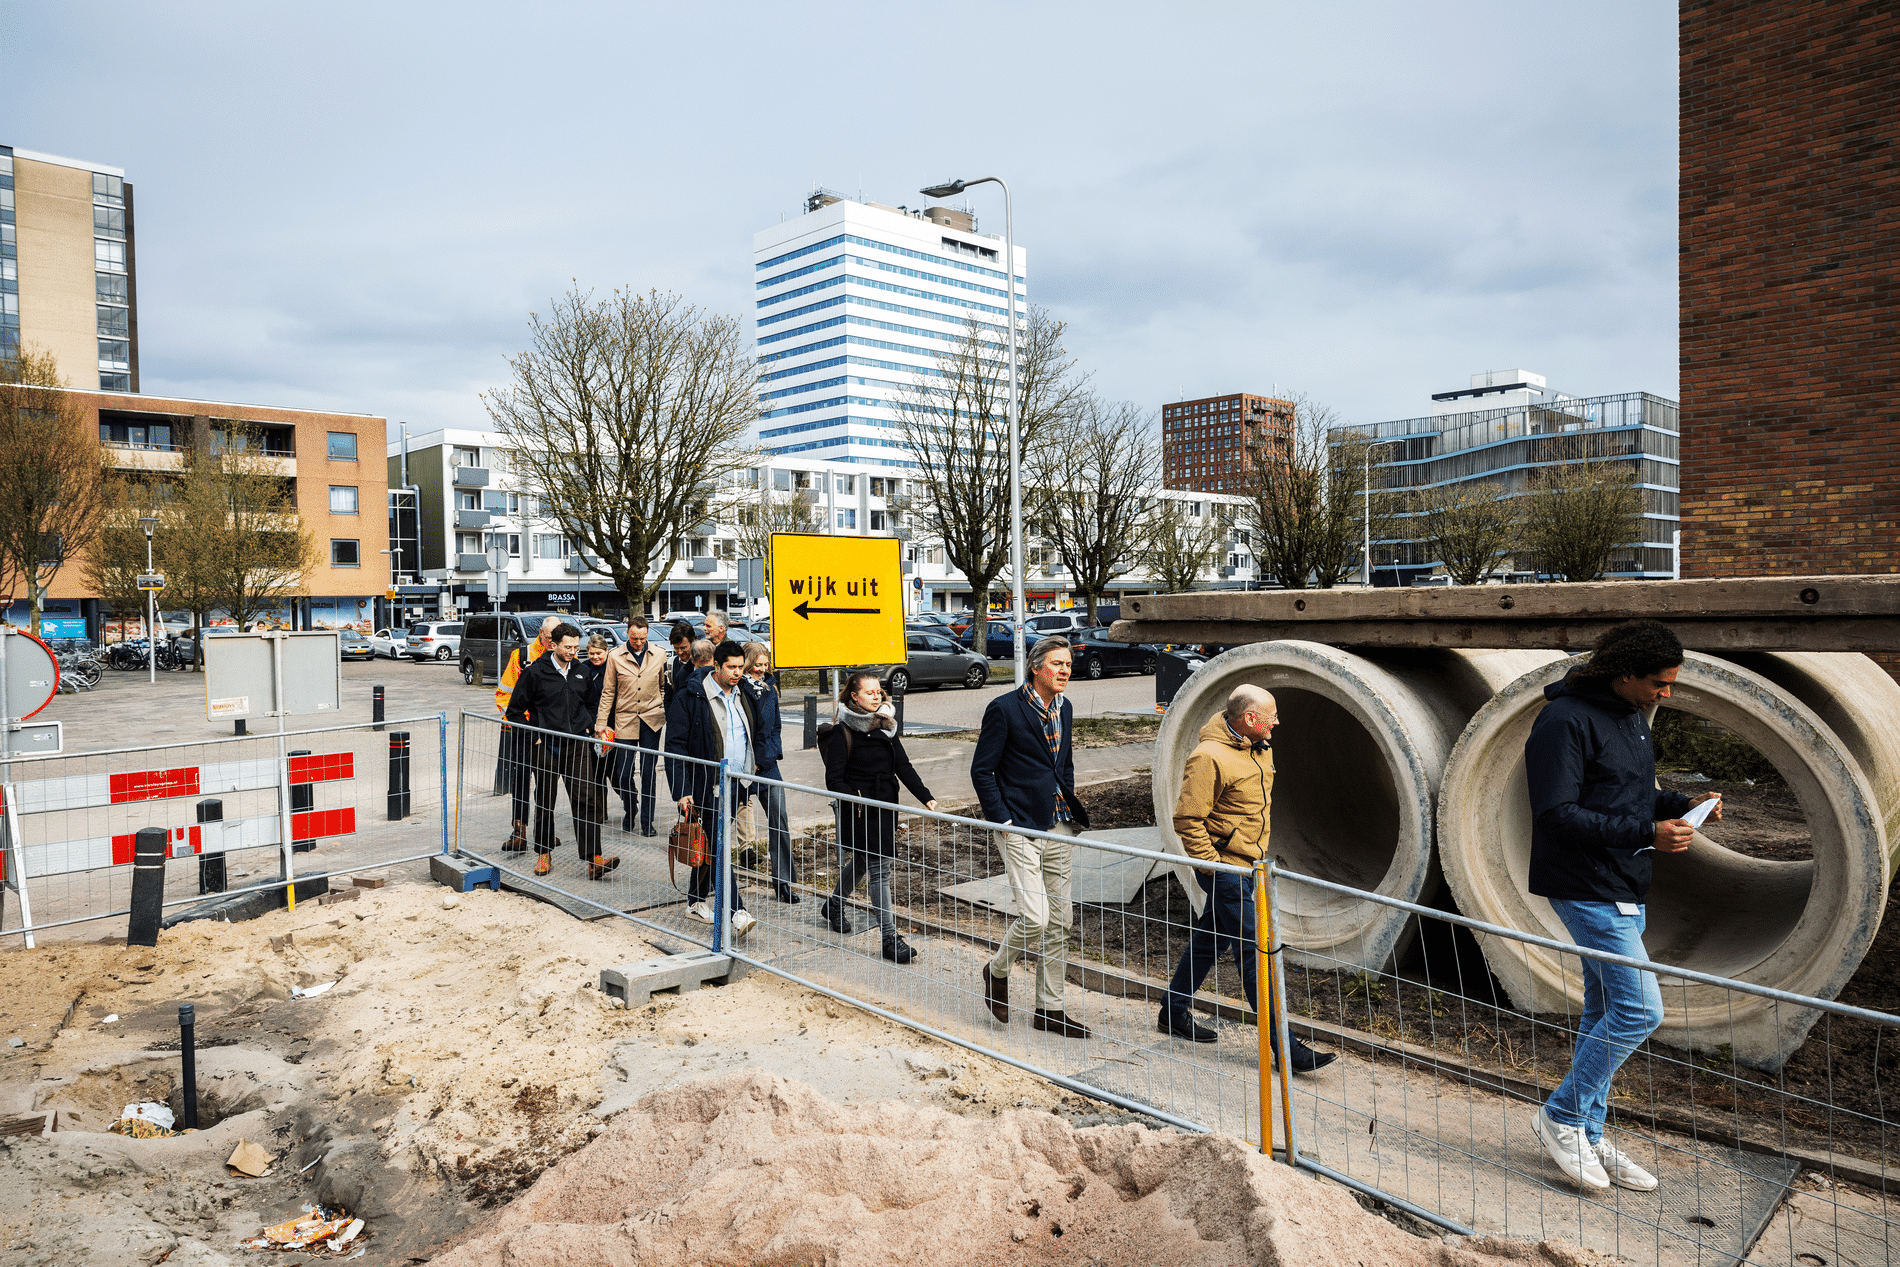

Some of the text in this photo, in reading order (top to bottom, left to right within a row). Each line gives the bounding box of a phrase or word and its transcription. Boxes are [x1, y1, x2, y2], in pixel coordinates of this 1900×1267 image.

[548, 593, 576, 601] BRASSA
[789, 575, 878, 602] wijk uit
